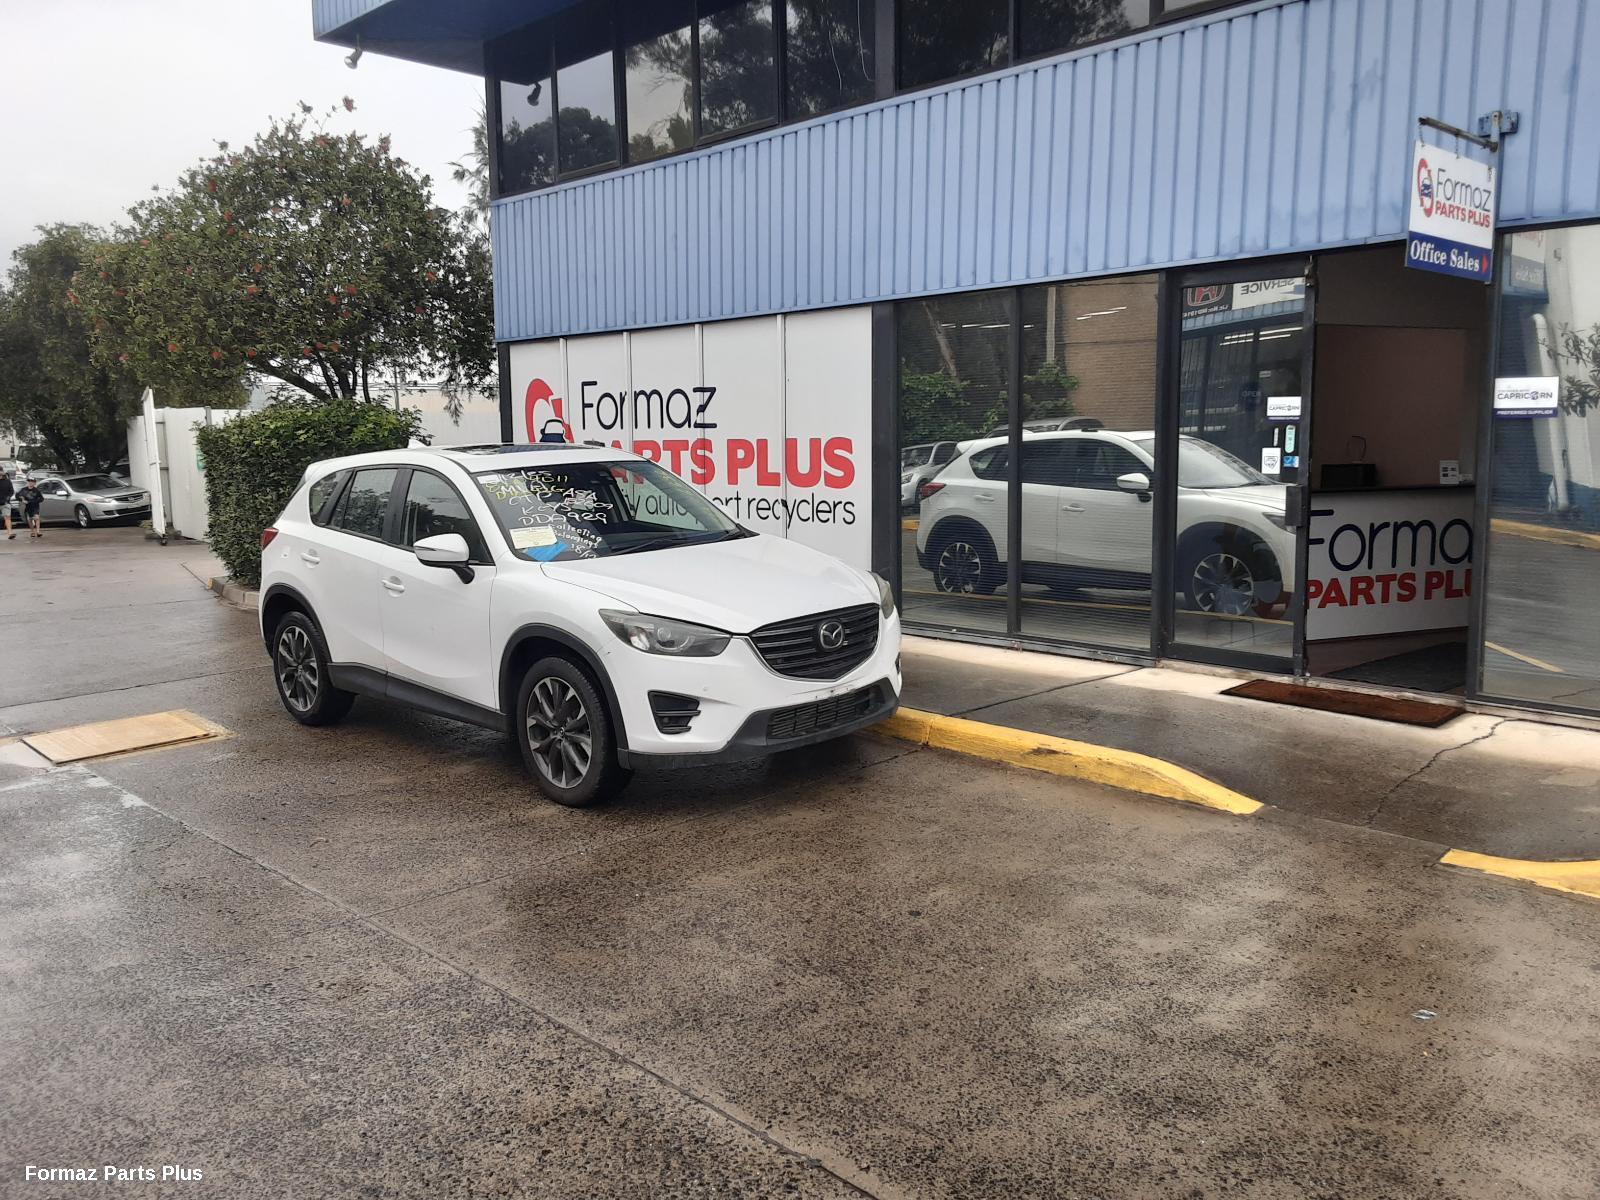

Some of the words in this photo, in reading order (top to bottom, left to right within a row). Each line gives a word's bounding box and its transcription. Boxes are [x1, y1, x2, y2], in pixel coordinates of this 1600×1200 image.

[1435, 168, 1492, 212] Formaz
[1434, 200, 1467, 222] PARTS
[1467, 209, 1491, 228] PLUS
[1410, 240, 1447, 266] Office
[1449, 248, 1480, 272] Sales
[581, 380, 718, 431] Formaz
[610, 438, 716, 485] RTS
[727, 436, 856, 489] PLUS
[747, 492, 856, 530] recyclers
[1306, 572, 1417, 610] PARTS
